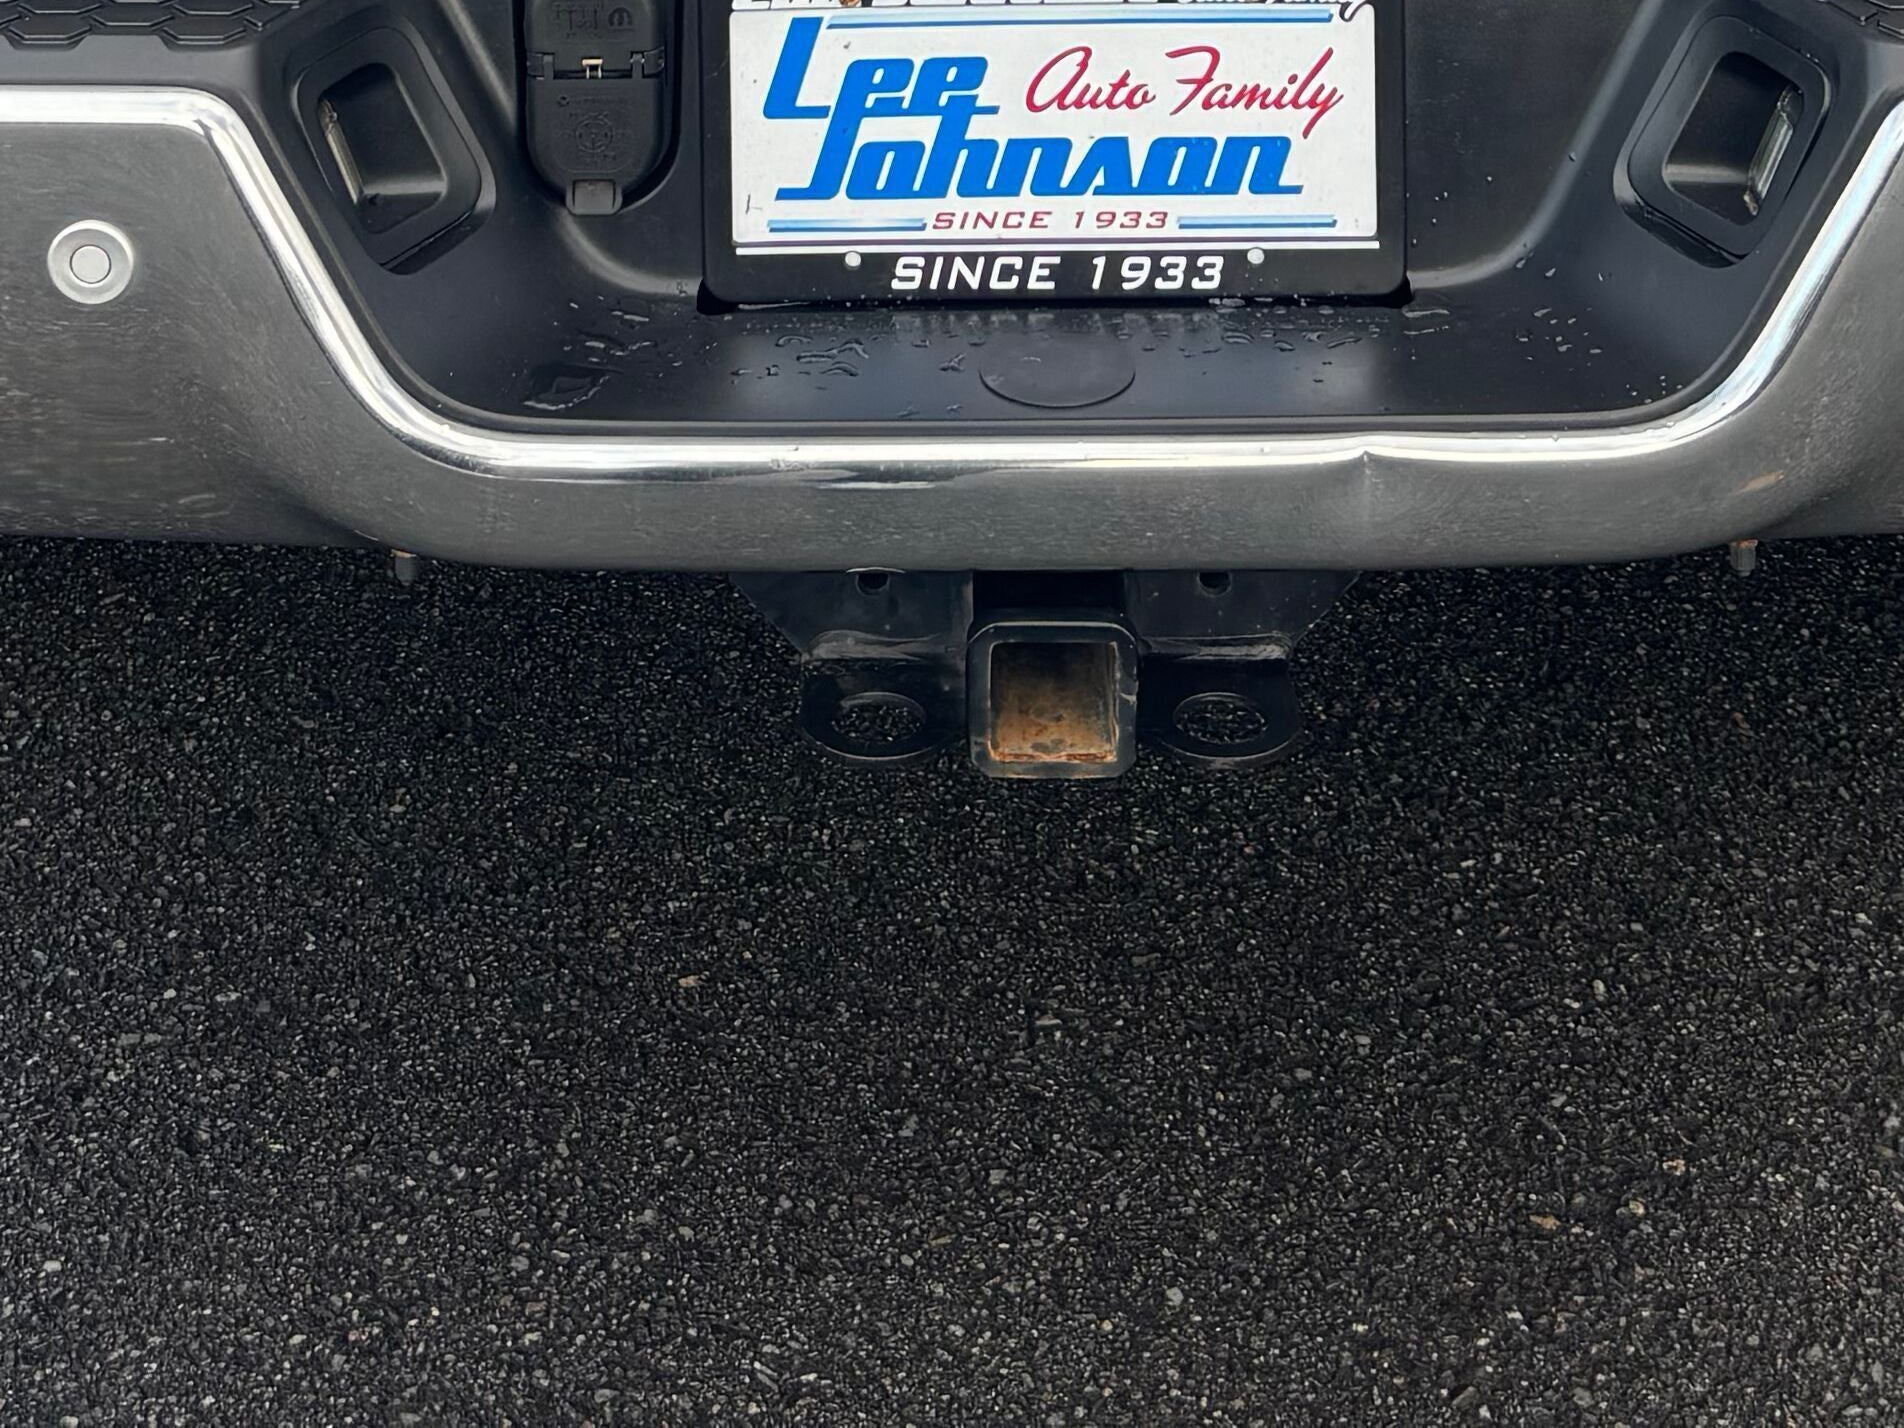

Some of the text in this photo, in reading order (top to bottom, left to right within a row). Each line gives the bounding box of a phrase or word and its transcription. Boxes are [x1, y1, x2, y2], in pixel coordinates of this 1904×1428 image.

[762, 17, 1001, 120] Lee
[1025, 45, 1346, 140] Auto Family
[775, 110, 1304, 201] Johnson
[933, 209, 1169, 231] SINCE 1933
[890, 254, 1226, 291] SINCE 1933
